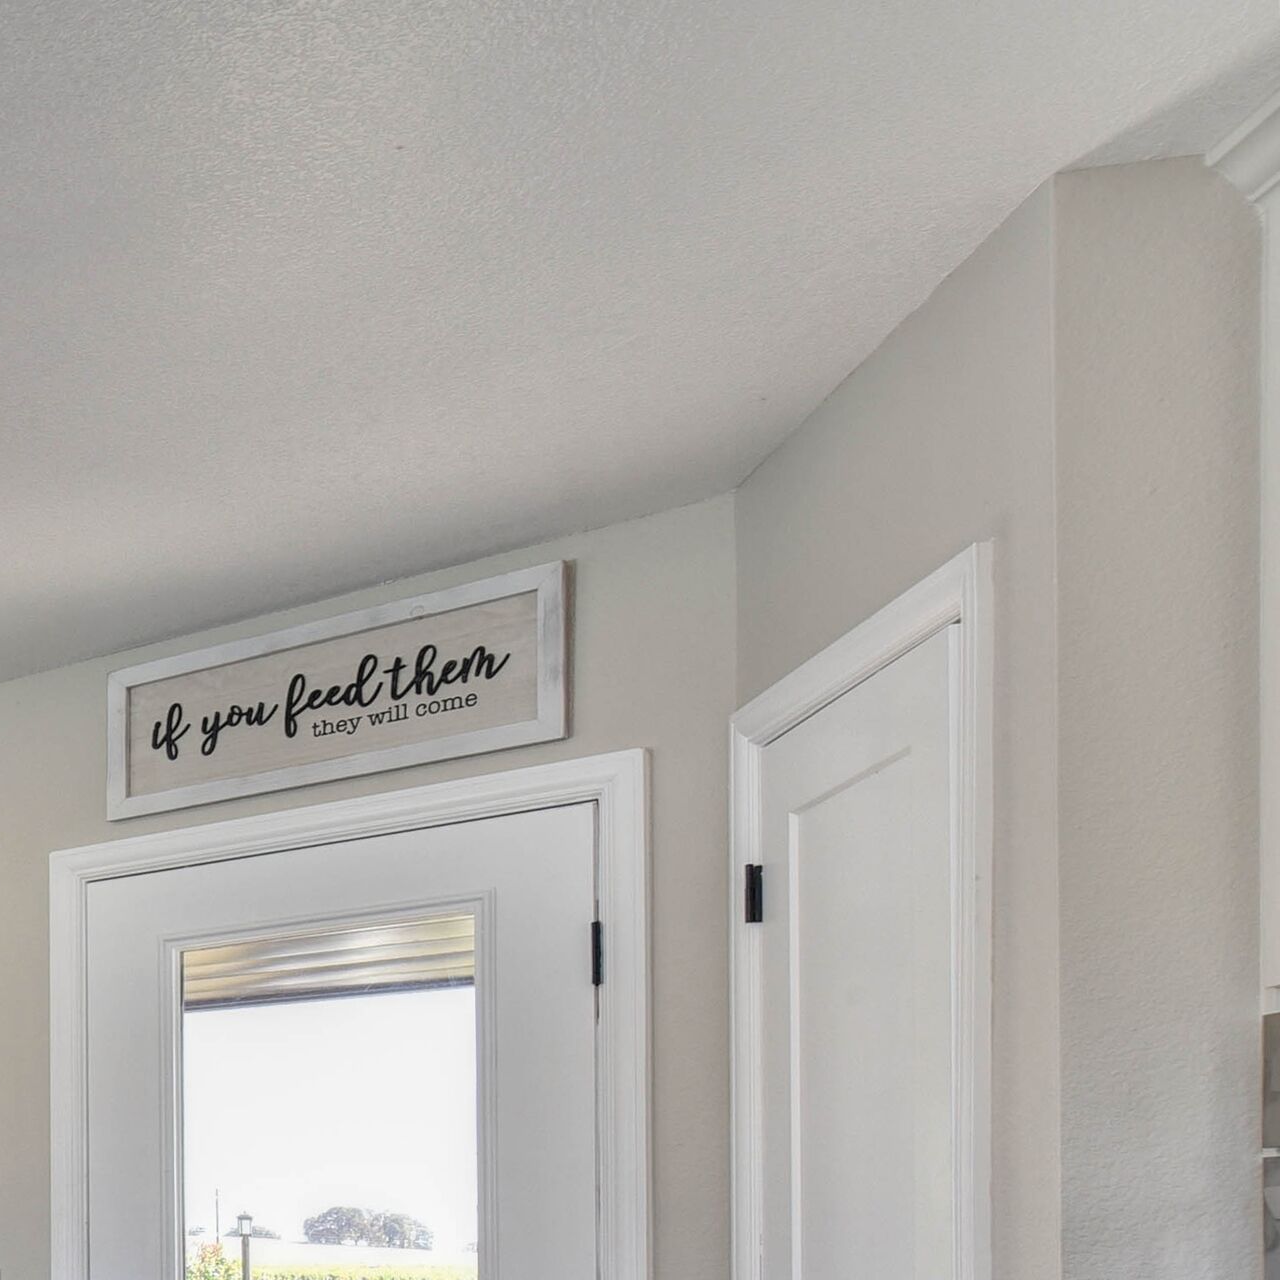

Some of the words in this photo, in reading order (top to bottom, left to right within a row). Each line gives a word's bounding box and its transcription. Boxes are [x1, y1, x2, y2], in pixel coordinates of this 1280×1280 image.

[151, 702, 192, 761] if
[200, 700, 278, 757] you
[283, 653, 384, 738] feed
[386, 644, 511, 702] them
[311, 714, 362, 738] they
[367, 702, 410, 726] will
[415, 690, 478, 717] come
